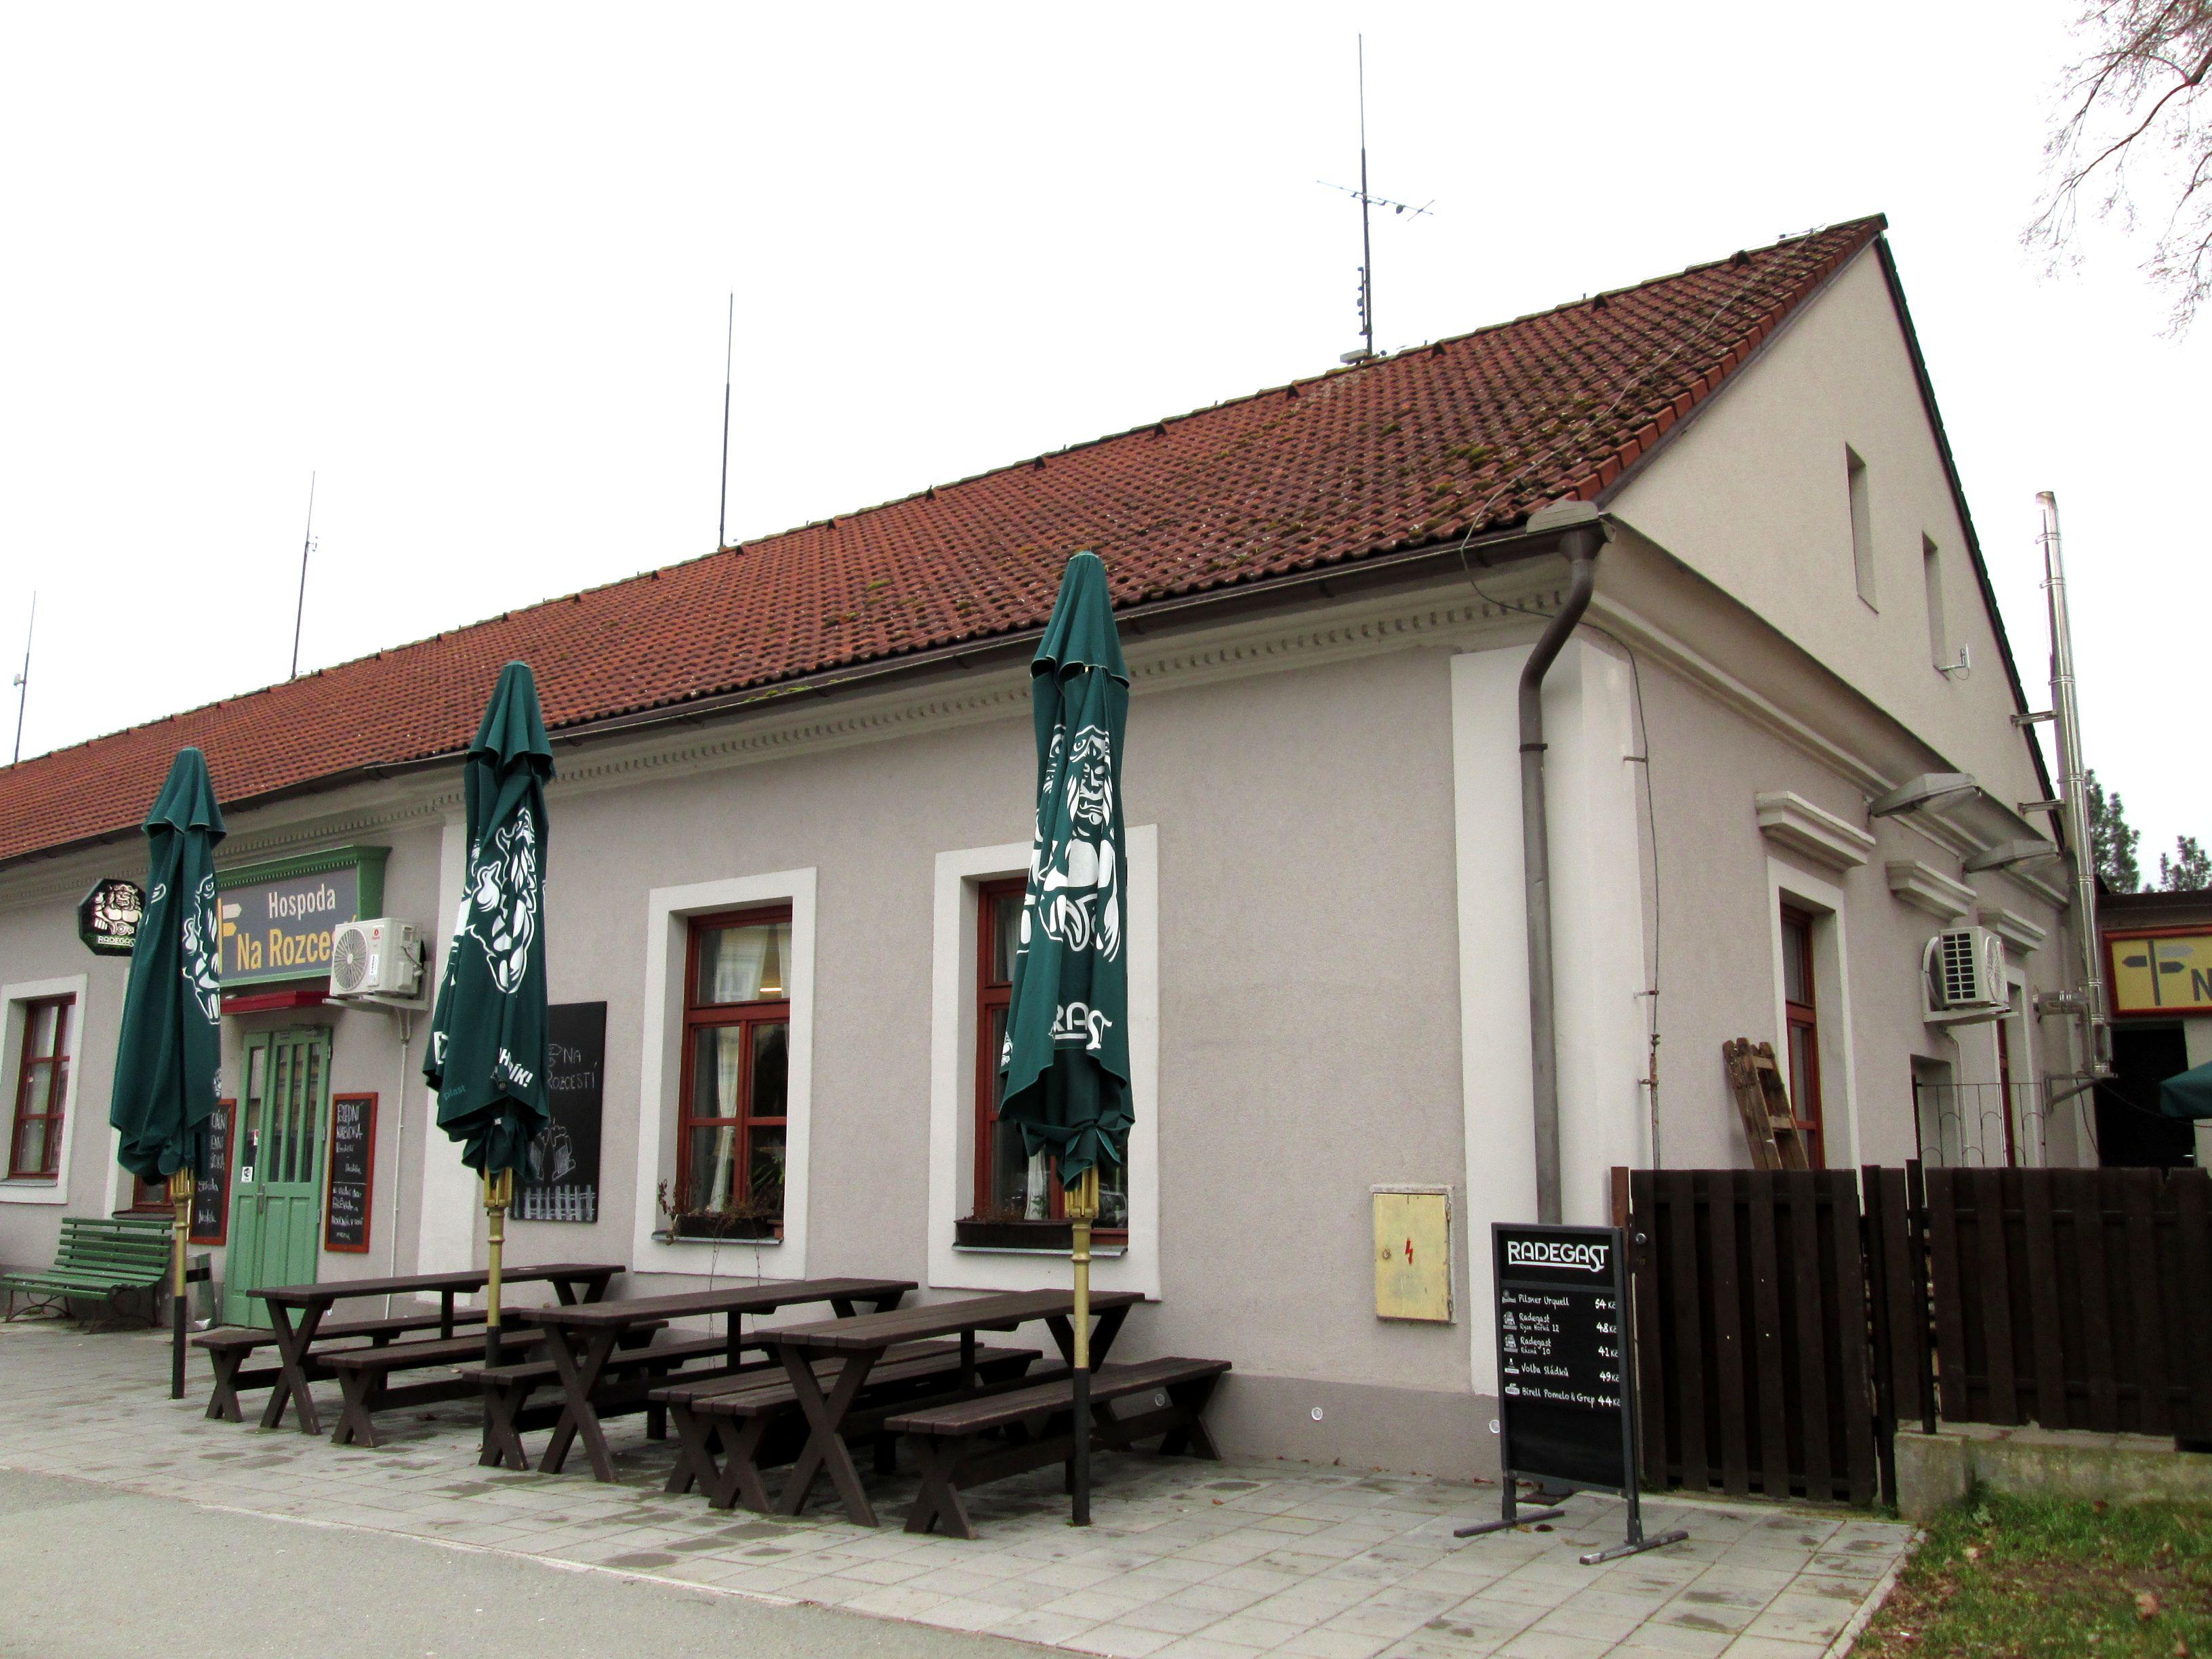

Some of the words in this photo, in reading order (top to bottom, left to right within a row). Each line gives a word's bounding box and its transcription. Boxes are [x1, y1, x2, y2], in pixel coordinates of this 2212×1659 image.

[268, 884, 336, 920] Hospoda
[98, 936, 136, 947] RADEGAS
[237, 933, 262, 971] Na
[270, 922, 335, 967] Rozce
[563, 1049, 581, 1063] NA
[1507, 1241, 1610, 1272] RADEGAST
[1518, 1294, 1542, 1304] Pilsner
[1544, 1296, 1570, 1309] Urquell
[1608, 1300, 1616, 1309] Kč
[1519, 1313, 1550, 1326] Radegast
[1553, 1324, 1559, 1333] 12
[1596, 1322, 1608, 1333] 48
[1520, 1336, 1551, 1349] Radegast
[1598, 1346, 1610, 1357] 41
[1599, 1371, 1612, 1382] 49
[1612, 1374, 1619, 1382] Kč
[1522, 1387, 1541, 1397] Birell
[1544, 1389, 1570, 1400] Pomelo
[1576, 1393, 1595, 1408] Grep
[1597, 1395, 1612, 1406] 44
[1613, 1397, 1620, 1406] Kč
